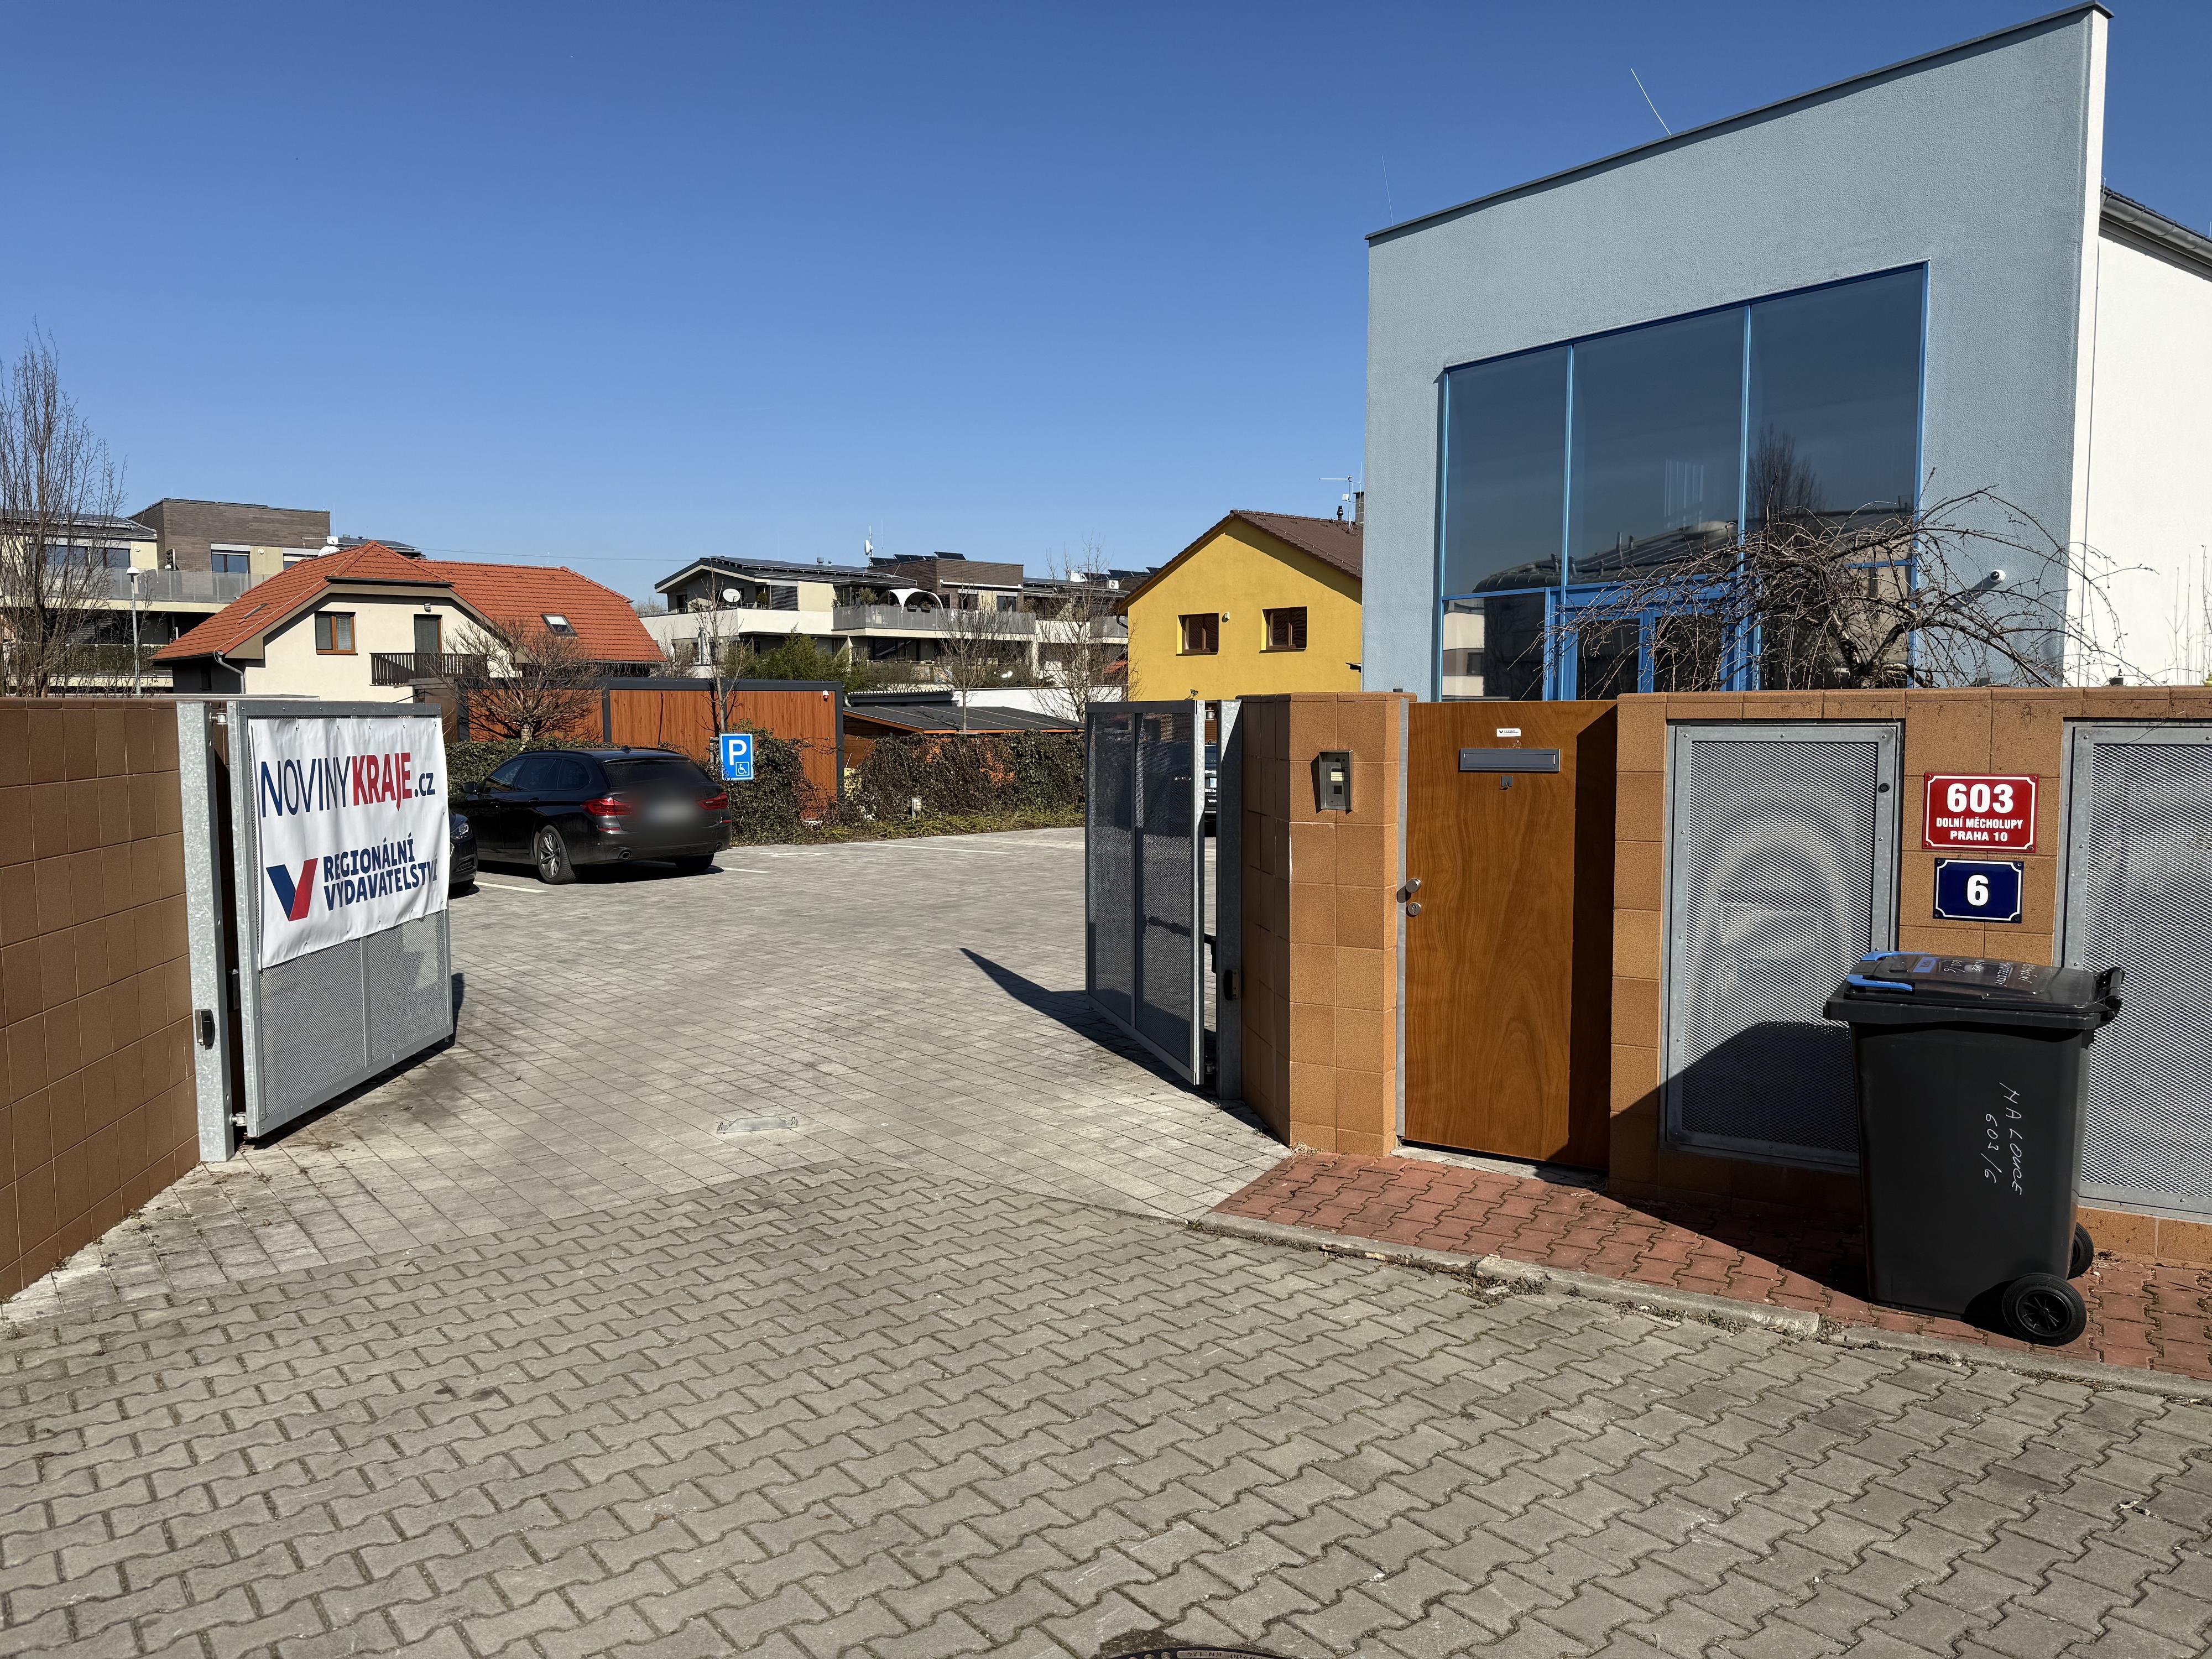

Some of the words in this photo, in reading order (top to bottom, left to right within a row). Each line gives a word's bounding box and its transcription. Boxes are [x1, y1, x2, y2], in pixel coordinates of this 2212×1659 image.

[728, 739, 747, 765] P
[1947, 783, 2013, 813] 603
[1936, 816, 1964, 828] DOLNÍ
[1965, 816, 2023, 829] MĚCHOLUPY
[1950, 831, 1989, 841] PRAHA
[1993, 832, 2008, 842] 10
[323, 832, 415, 883] REGIONÁLNÍ
[324, 853, 438, 911] VYDAVATELSTVÍ
[1967, 874, 1989, 906] 6
